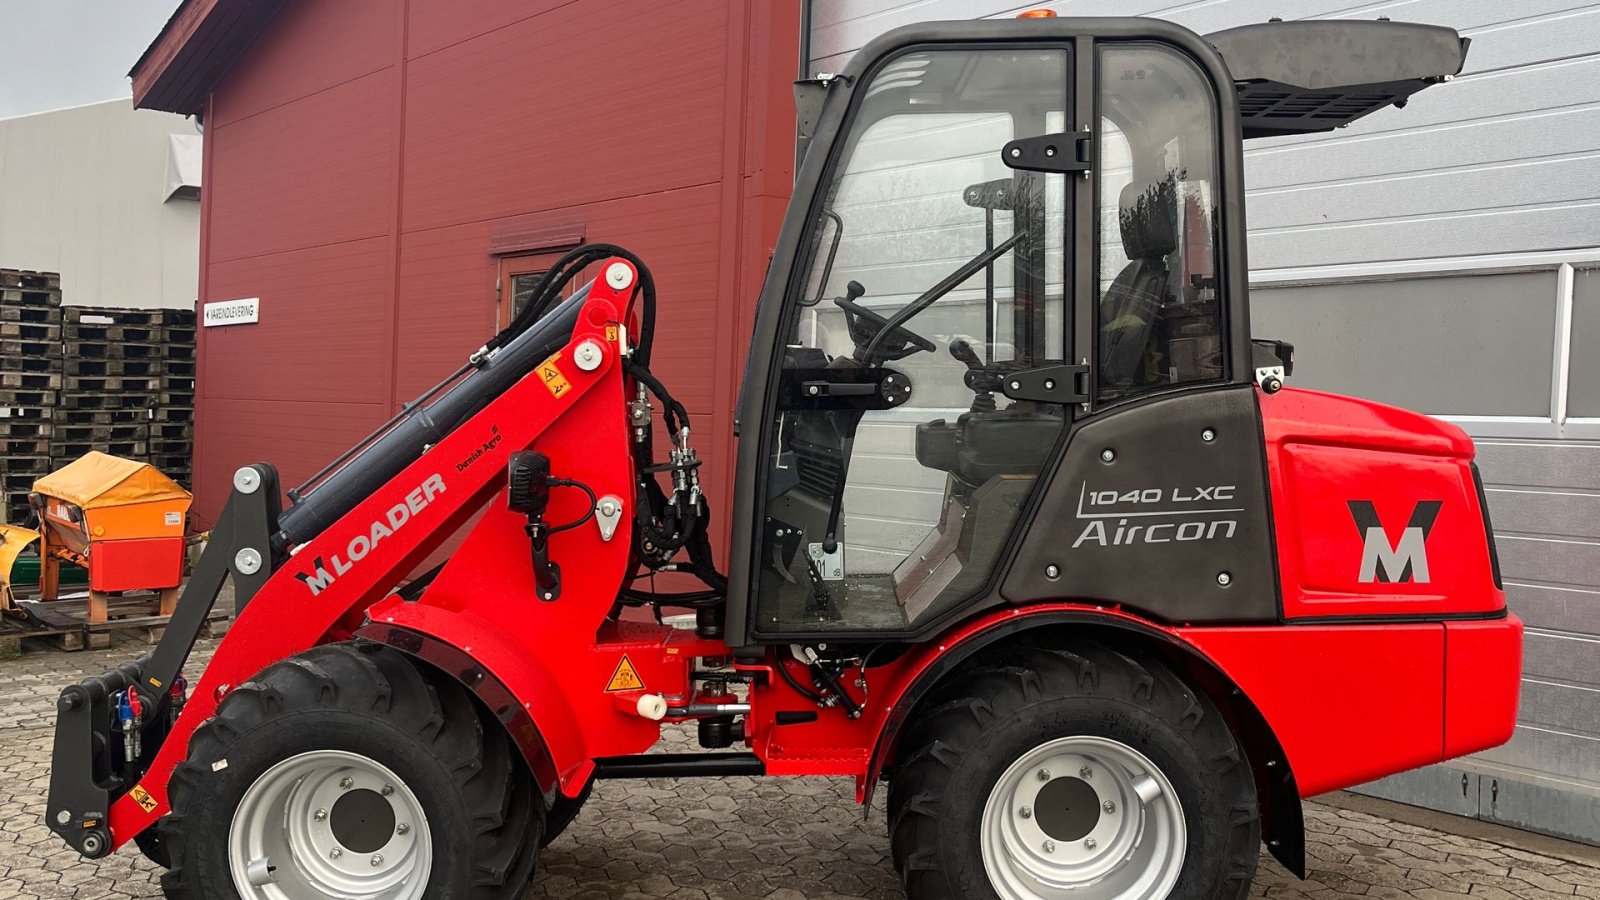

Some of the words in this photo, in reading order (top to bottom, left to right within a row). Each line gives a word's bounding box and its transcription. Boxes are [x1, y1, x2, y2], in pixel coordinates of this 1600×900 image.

[211, 304, 254, 319] VAREINDLEVERING
[457, 449, 483, 472] Danish
[482, 434, 502, 451] Agro
[1090, 489, 1162, 505] 1040
[1172, 485, 1236, 502] LXC
[330, 473, 447, 577] LOADER
[1072, 519, 1237, 548] Aircon
